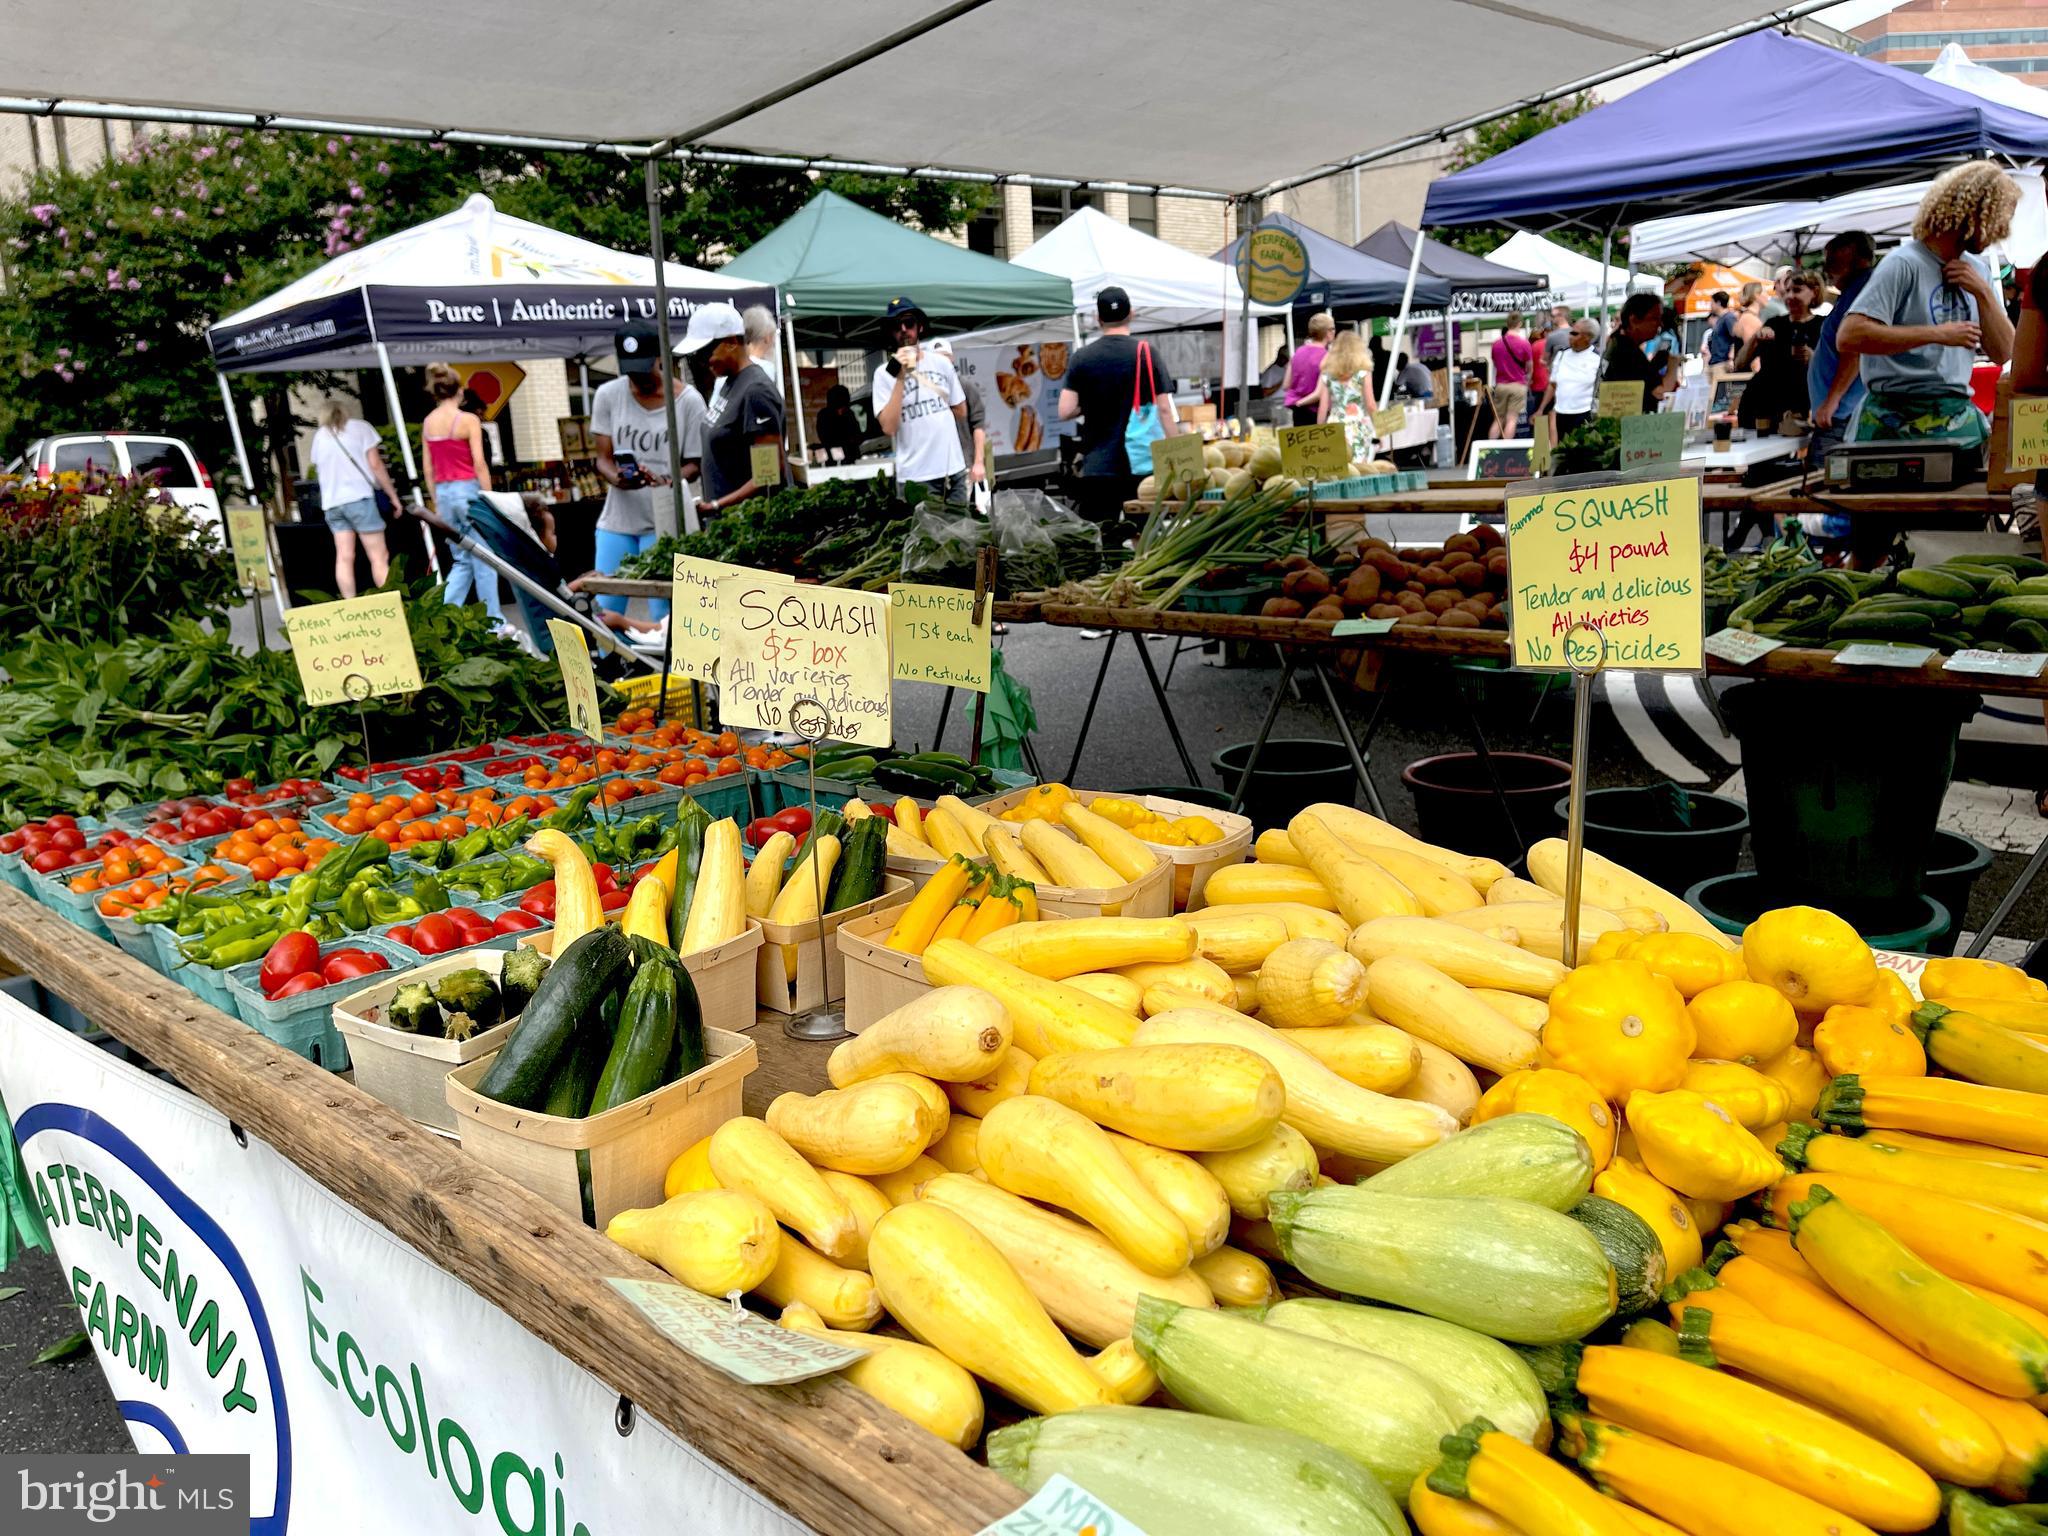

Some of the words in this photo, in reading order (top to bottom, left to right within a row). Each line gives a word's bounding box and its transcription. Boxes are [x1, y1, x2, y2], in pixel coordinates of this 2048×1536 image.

[1251, 234, 1302, 259] ATERPENNY
[426, 299, 486, 323] Pure
[511, 298, 615, 322] Authentic
[1449, 292, 1478, 312] OCAL
[2018, 403, 2048, 417] CUC
[1286, 426, 1336, 448] BEETS
[1554, 486, 1669, 532] SQUASH
[1569, 538, 1598, 574] $4
[1610, 531, 1669, 572] pound
[891, 588, 973, 612] JALAPEÑO
[1519, 583, 1579, 610] Tender
[1581, 581, 1605, 601] and
[1612, 577, 1692, 601] delicious
[287, 616, 332, 633] CHERRY
[739, 589, 877, 639] SQUASH
[1552, 611, 1573, 637] All
[309, 634, 329, 647] All
[904, 621, 941, 641] 75¢
[945, 627, 974, 645] each
[312, 654, 353, 672] 6.00
[362, 649, 385, 666] box
[761, 628, 803, 669] $5
[811, 639, 848, 669] box
[1526, 637, 1552, 662] No
[1566, 634, 1681, 662] Pesticides
[730, 657, 755, 684] All
[898, 662, 919, 676] No
[925, 664, 982, 685] Pesticides
[310, 687, 333, 703] No
[729, 677, 786, 705] Tender
[35, 1163, 257, 1414] ATERPENNY
[72, 1265, 169, 1390] FARM
[299, 1263, 592, 1536] Ecologi
